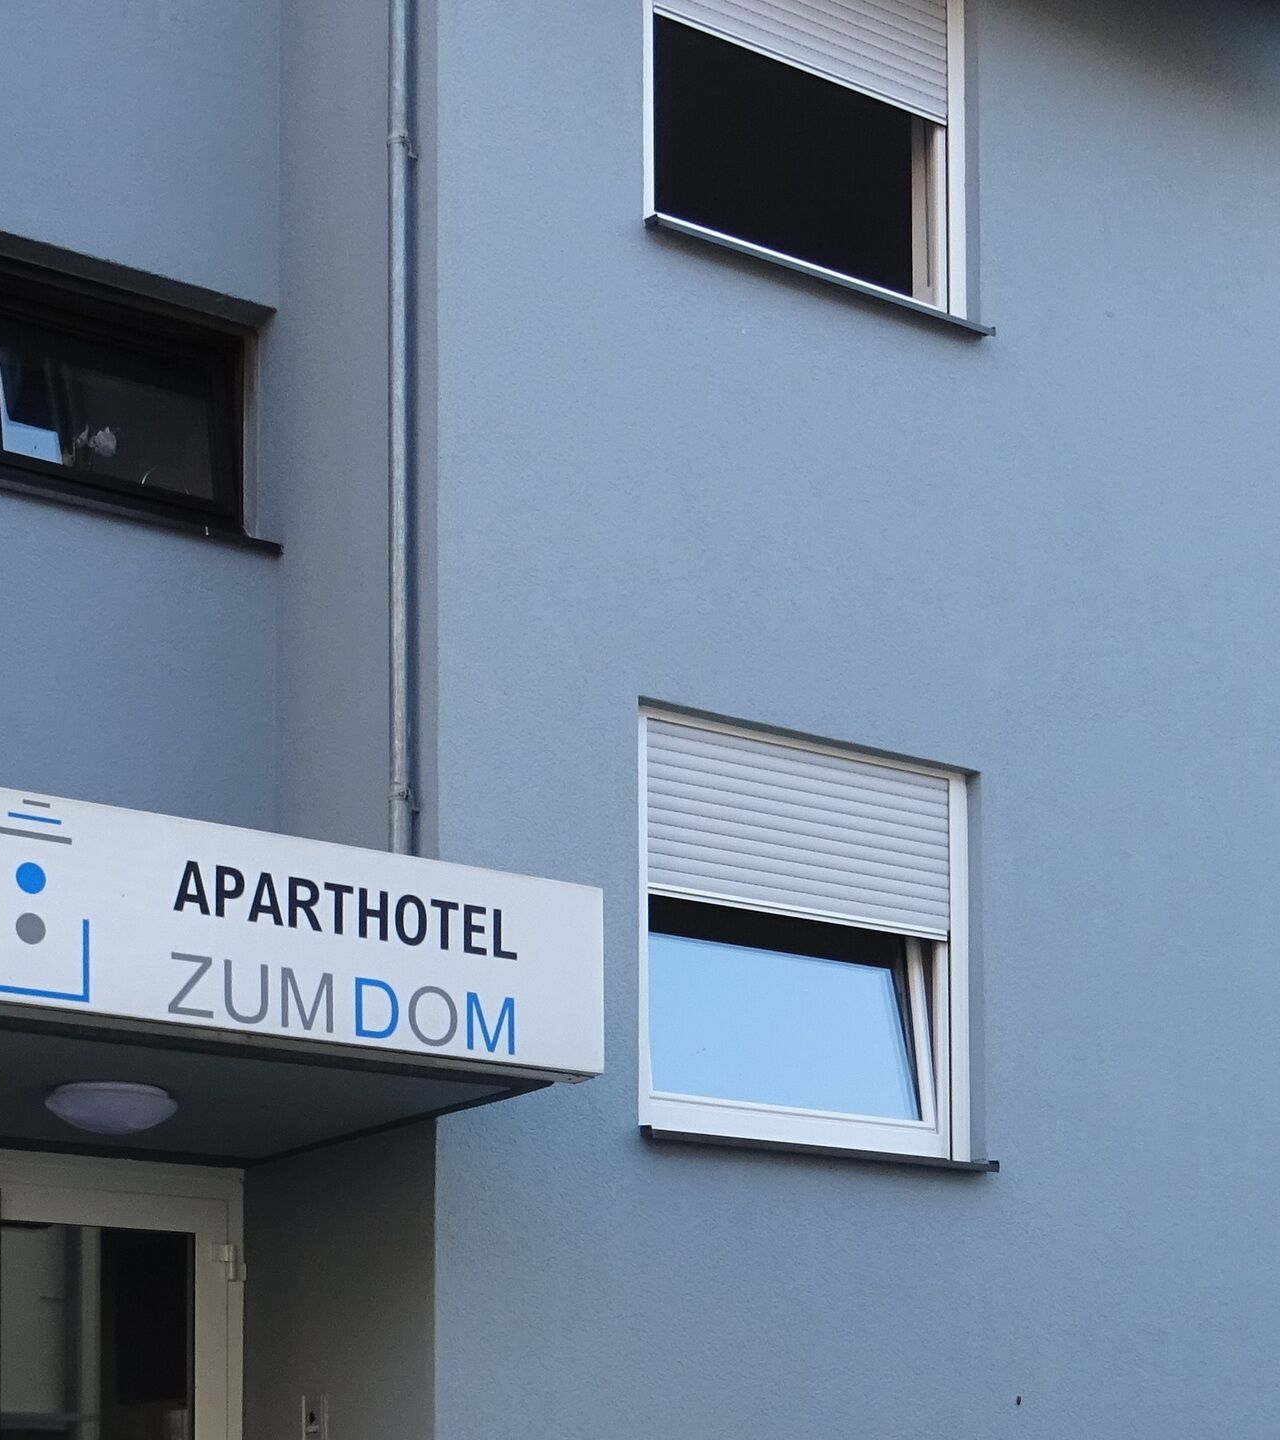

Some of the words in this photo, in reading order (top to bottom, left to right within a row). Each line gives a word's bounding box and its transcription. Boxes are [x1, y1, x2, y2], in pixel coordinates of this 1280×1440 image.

[173, 860, 518, 960] APARTHOTEL
[167, 952, 334, 1033] ZUM
[355, 977, 516, 1055] DOM
